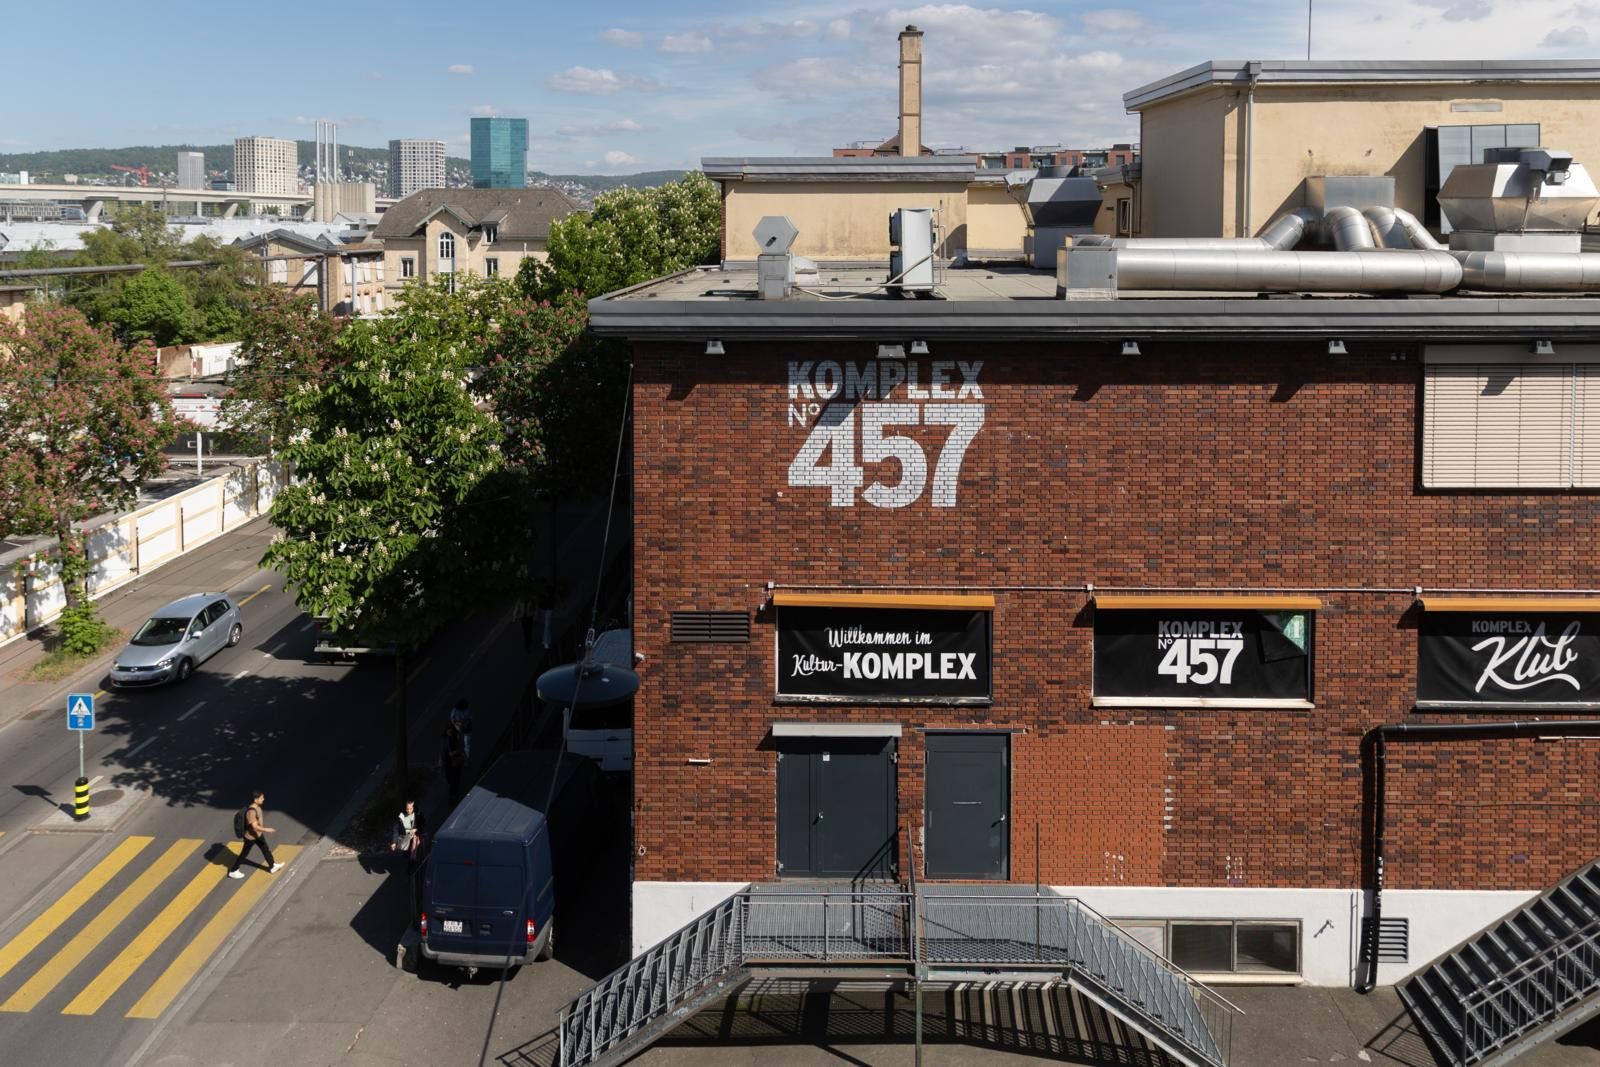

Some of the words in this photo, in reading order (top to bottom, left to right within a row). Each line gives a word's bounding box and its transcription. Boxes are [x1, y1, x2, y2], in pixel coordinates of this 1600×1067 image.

[787, 360, 985, 400] KOMPLEX
[787, 403, 985, 508] 457
[824, 624, 912, 648] Willkommen
[915, 630, 933, 645] im
[1157, 620, 1244, 639] KOMPLEX
[1471, 620, 1533, 633] KOMPLEX
[1157, 638, 1244, 685] 457
[1471, 621, 1581, 693] Klub
